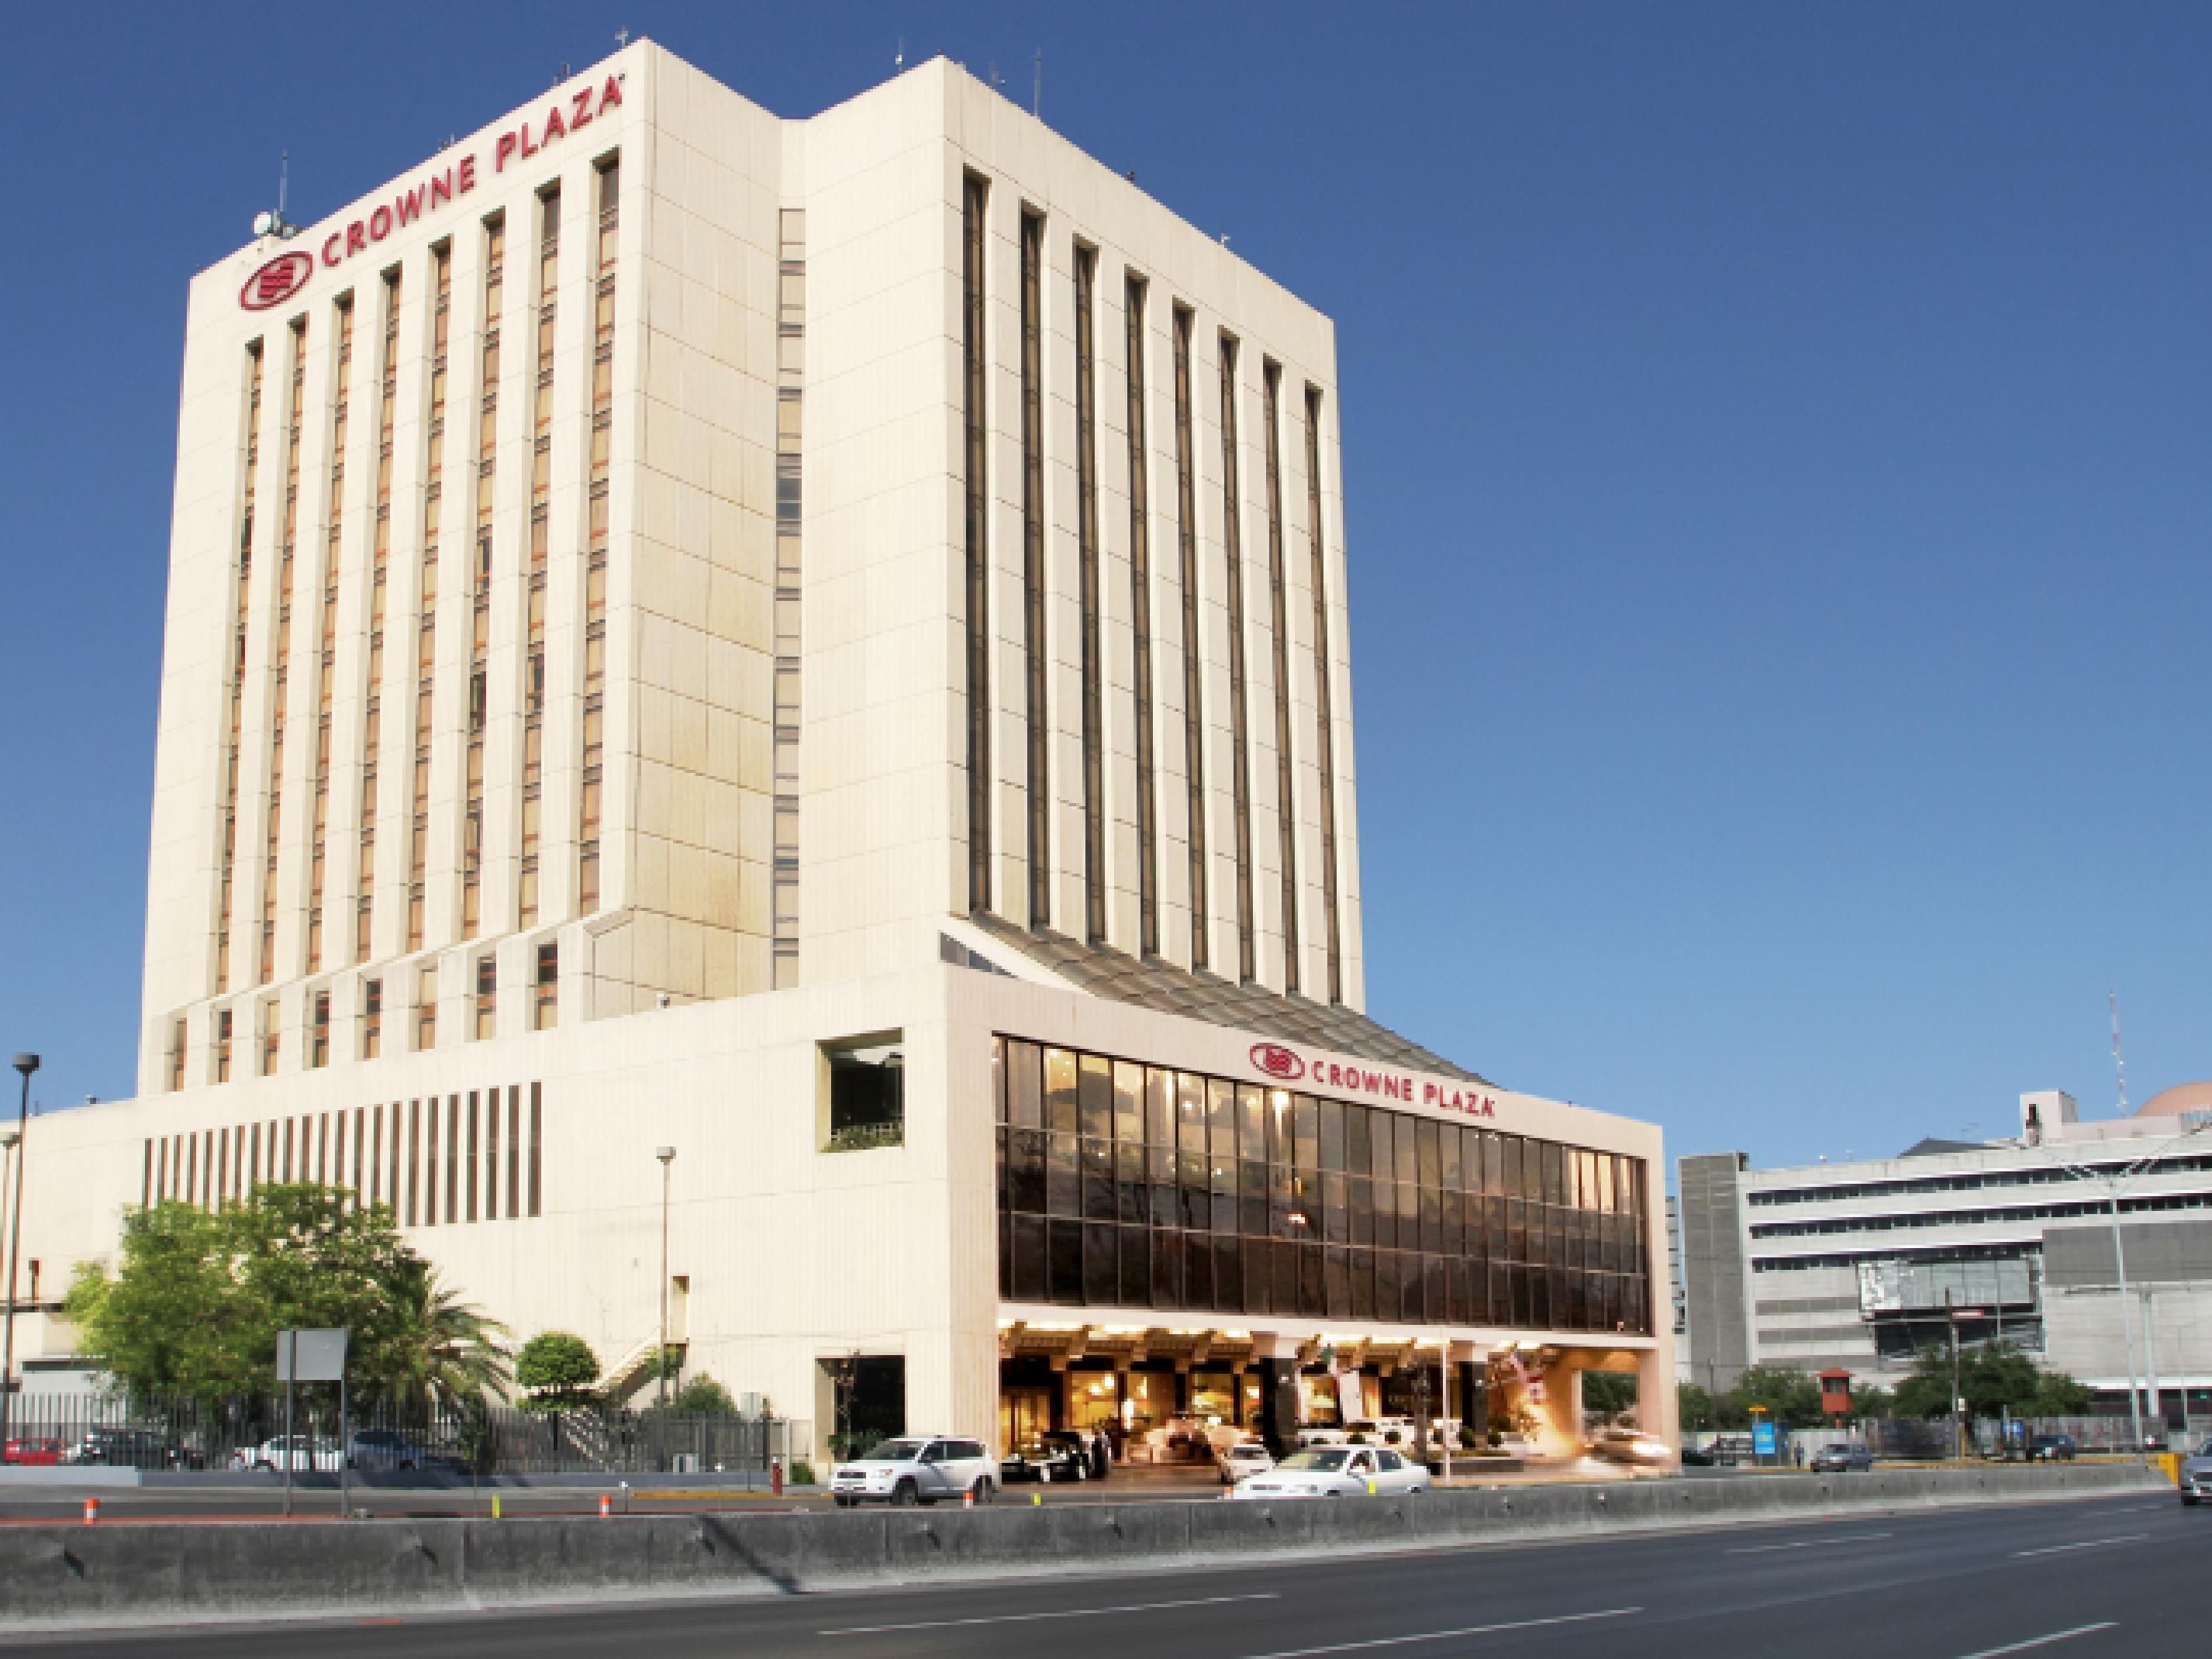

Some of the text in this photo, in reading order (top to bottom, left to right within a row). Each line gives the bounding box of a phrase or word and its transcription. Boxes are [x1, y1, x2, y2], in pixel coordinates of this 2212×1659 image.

[322, 74, 622, 266] CROWNE PLAZA
[1313, 1061, 1495, 1116] CROWNE PLAZA
